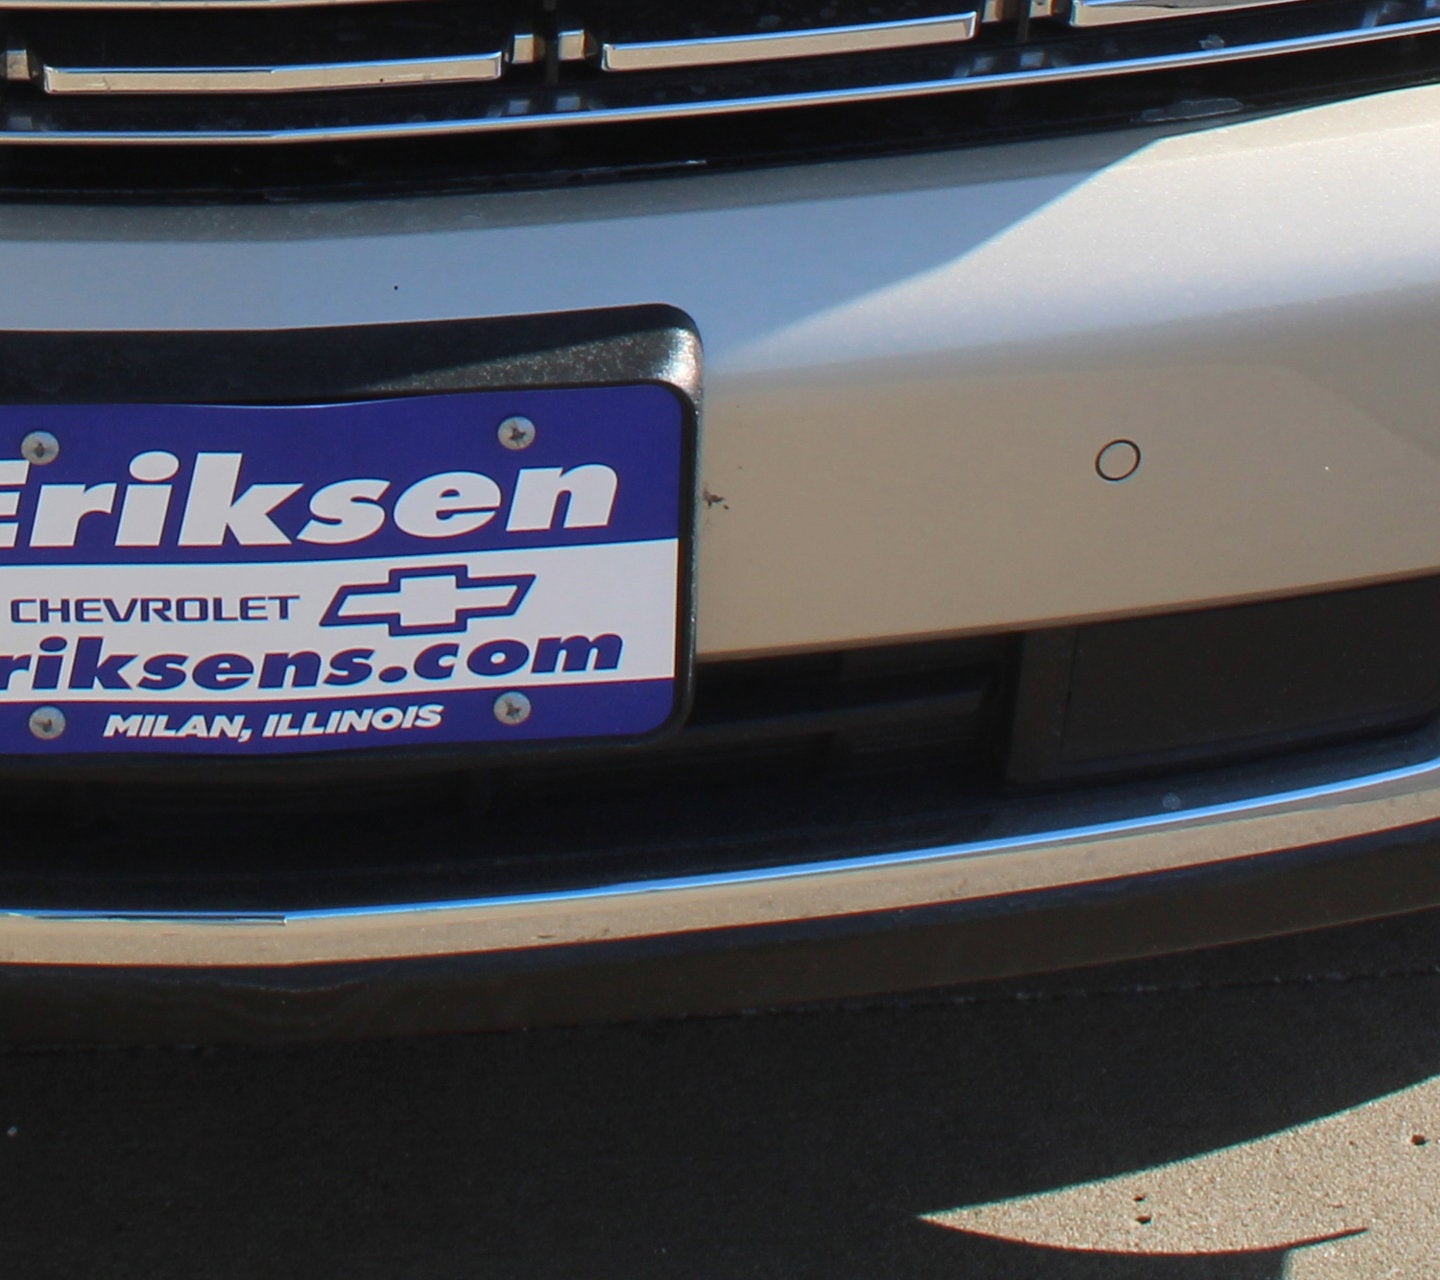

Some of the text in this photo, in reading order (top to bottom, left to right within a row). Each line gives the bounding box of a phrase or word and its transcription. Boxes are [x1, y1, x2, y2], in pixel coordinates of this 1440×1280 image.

[9, 595, 301, 624] CHEVROLET
[102, 704, 444, 743] MILAN, ILLINOIS
